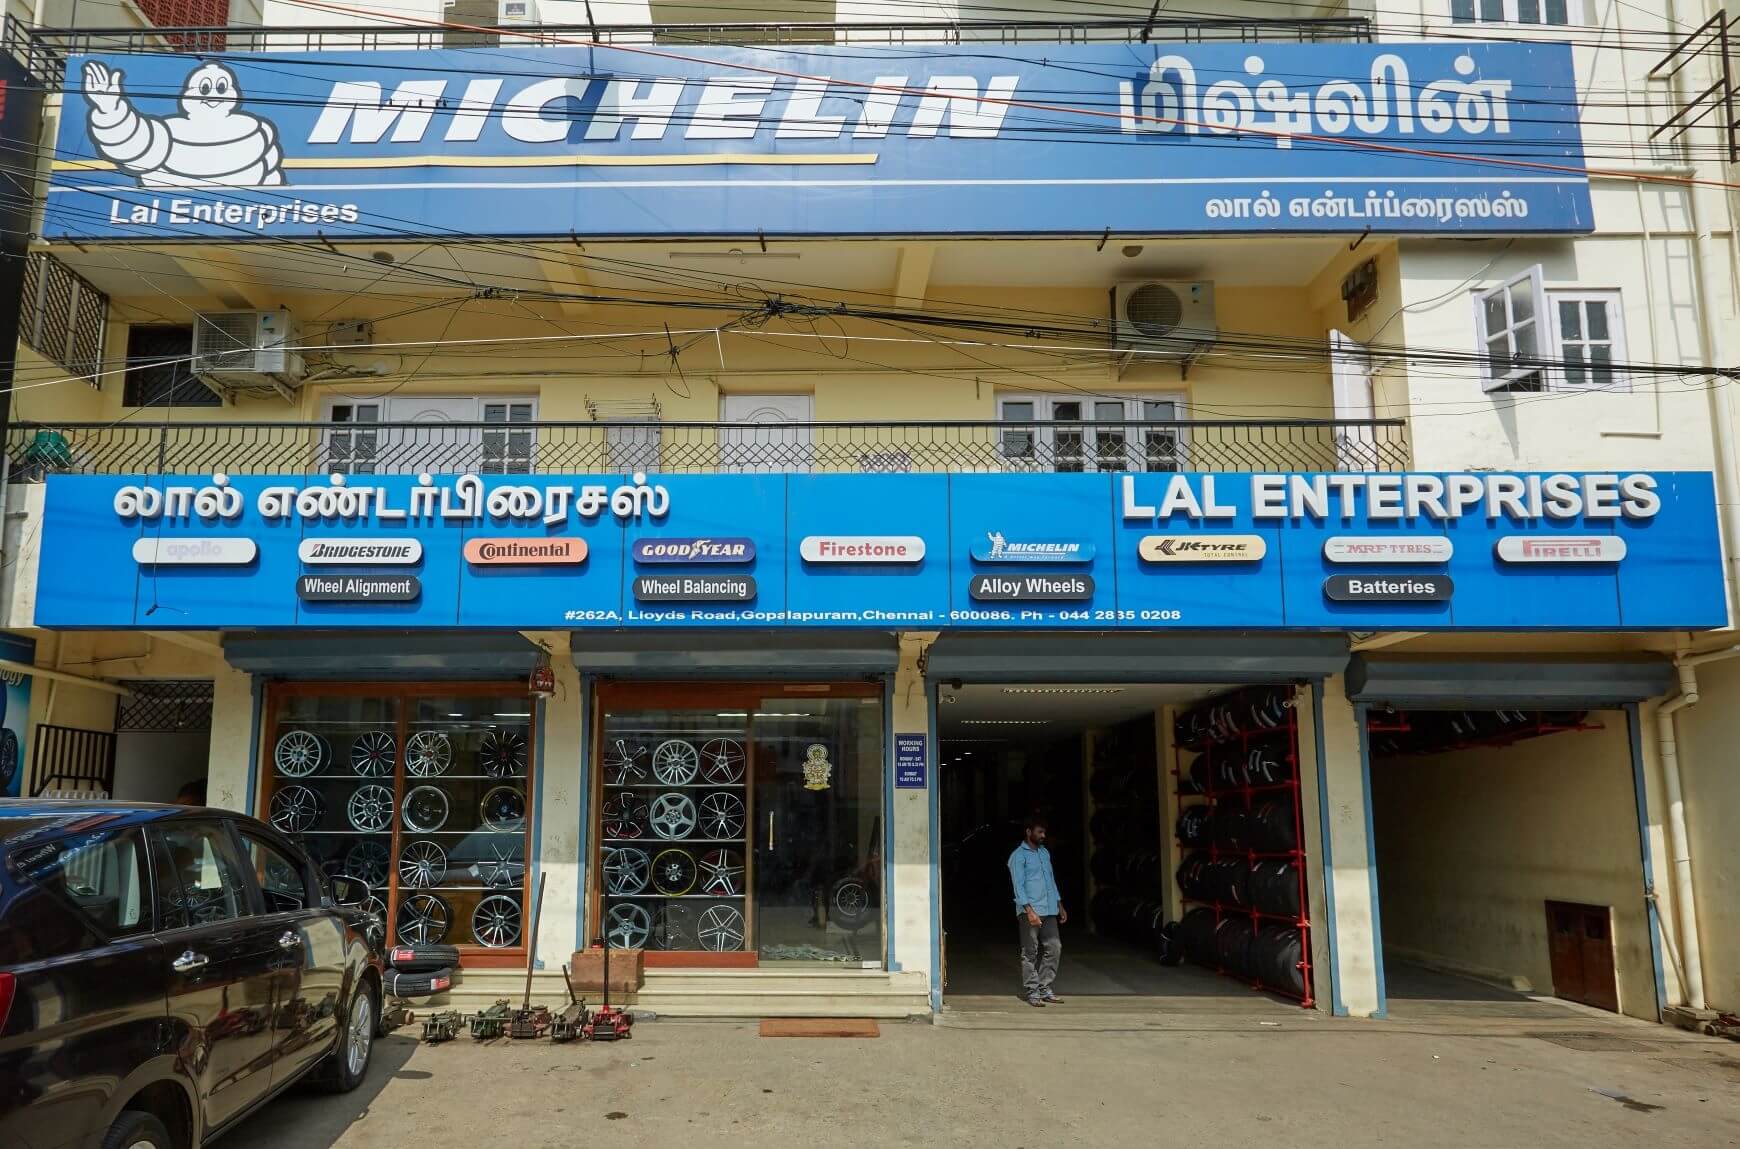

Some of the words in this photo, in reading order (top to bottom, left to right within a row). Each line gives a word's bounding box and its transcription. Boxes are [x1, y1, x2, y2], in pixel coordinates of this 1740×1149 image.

[307, 74, 1020, 145] MICHELIN
[1205, 190, 1281, 218] லால்
[109, 199, 157, 226] Lal
[169, 199, 359, 230] Enterprises
[113, 472, 244, 519] லால்
[1122, 474, 1237, 519] LAL
[1250, 473, 1662, 520] ENTERPRISES
[167, 541, 223, 560] apollo
[309, 543, 412, 558] BRIDGESTONE
[478, 542, 571, 560] Continental
[819, 541, 907, 556] Firestone
[1007, 543, 1080, 552] MICHELIN
[1346, 544, 1387, 554] MRF
[1389, 544, 1433, 554] TYRES
[1522, 539, 1602, 558] PIRELLI
[304, 578, 343, 594] Wheel
[345, 578, 411, 597] Alignment
[641, 579, 681, 595] Wheel
[683, 579, 748, 597] Balancing
[979, 578, 1022, 597] Alloy
[1025, 578, 1086, 594] Wheels
[1348, 580, 1436, 595] Batteries
[564, 610, 623, 623] #262A,
[628, 610, 686, 622] Lloyds
[950, 610, 1015, 621] 600086.
[1021, 610, 1043, 620] Ph
[1059, 610, 1090, 620] 044
[1140, 610, 1182, 620] 0208
